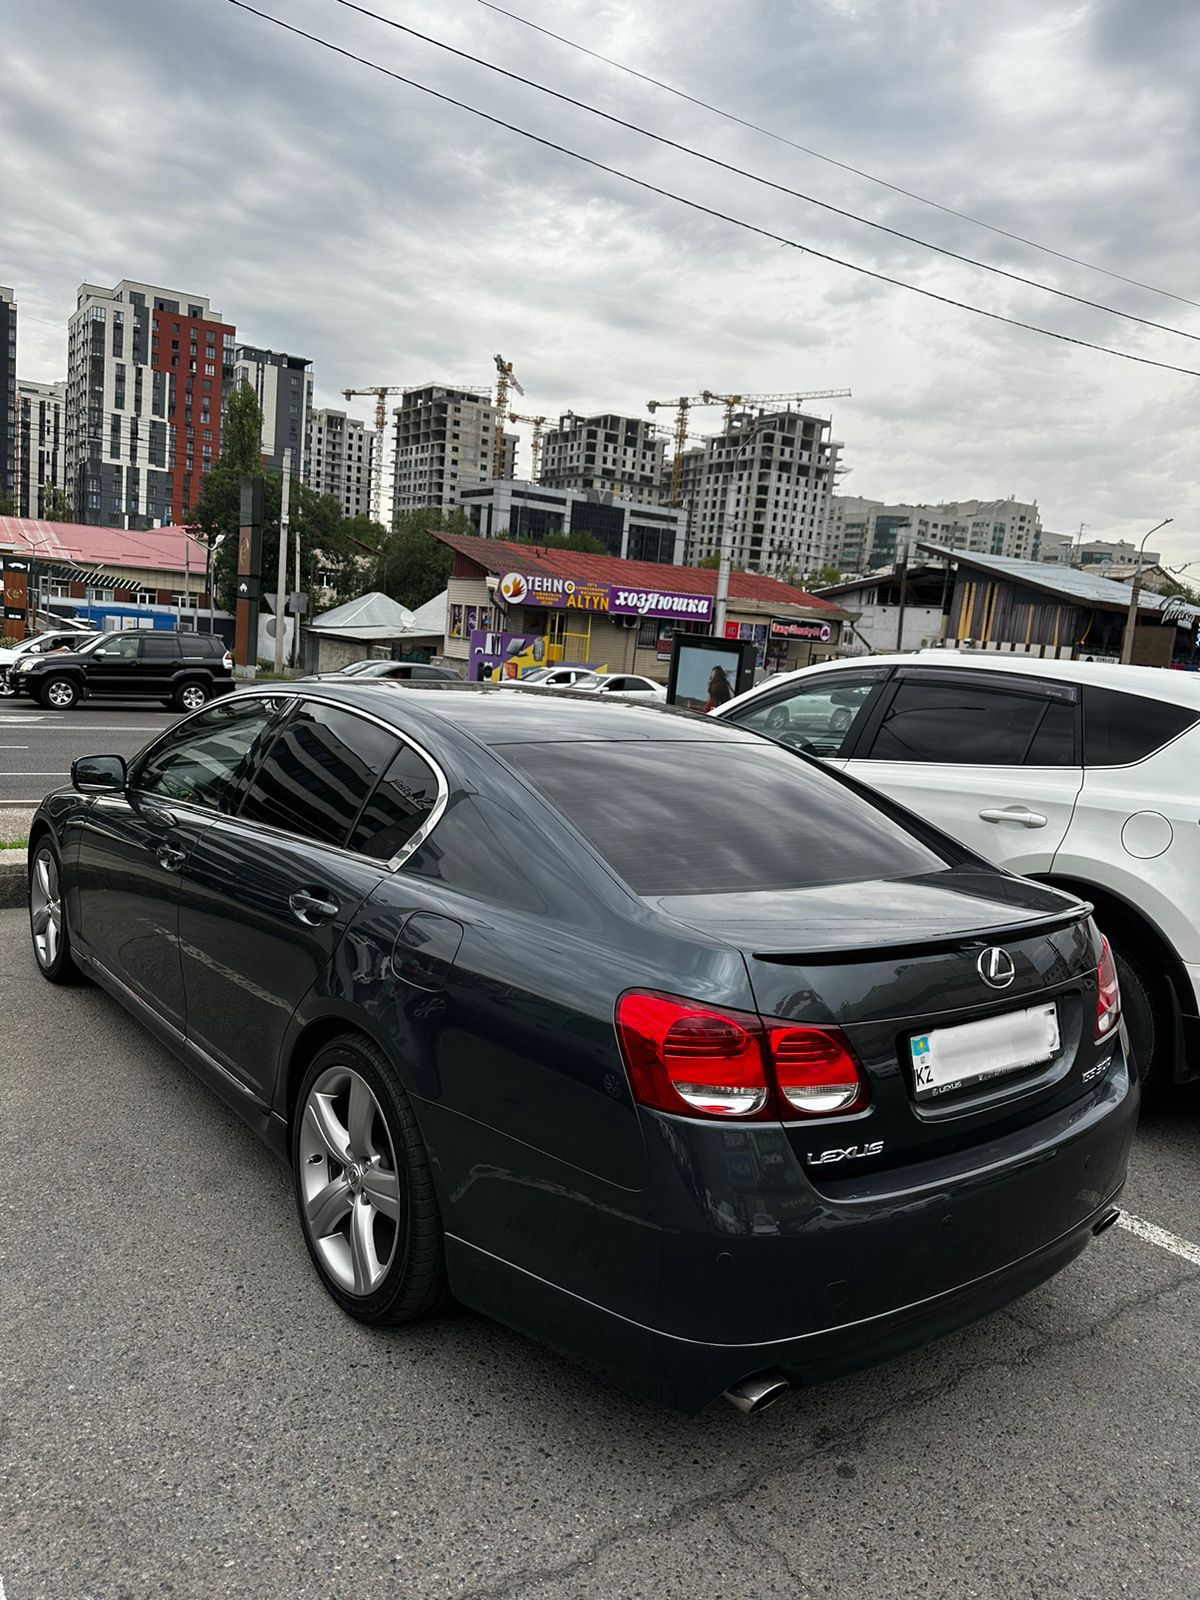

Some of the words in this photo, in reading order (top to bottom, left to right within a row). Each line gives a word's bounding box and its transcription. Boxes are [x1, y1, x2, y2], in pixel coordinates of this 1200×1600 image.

[526, 576, 576, 594] TEHNO
[566, 594, 609, 611] ALTYN
[915, 1065, 934, 1086] KZ
[939, 1081, 963, 1093] LEXUS
[806, 1140, 885, 1165] LEXUS
